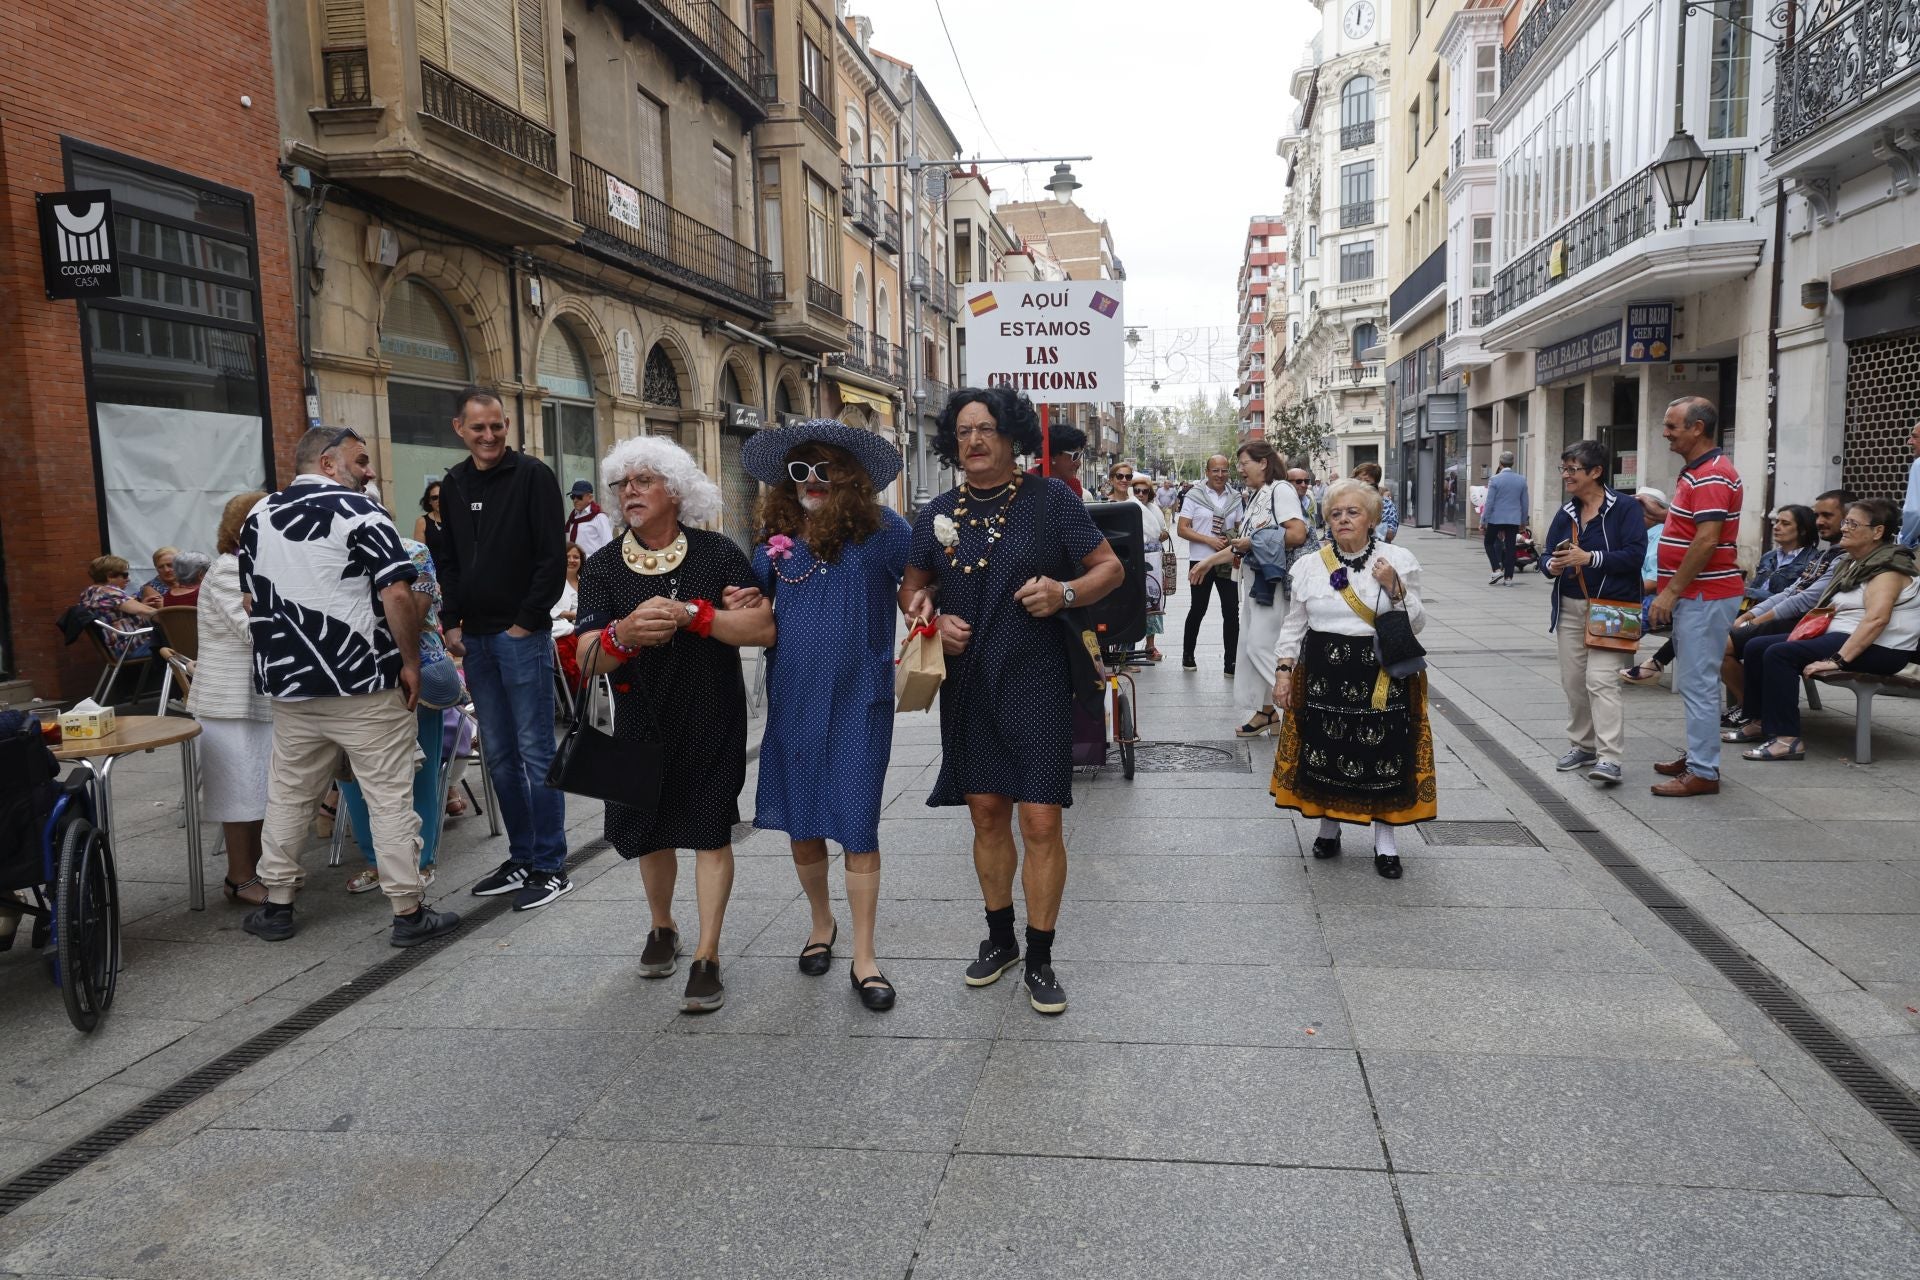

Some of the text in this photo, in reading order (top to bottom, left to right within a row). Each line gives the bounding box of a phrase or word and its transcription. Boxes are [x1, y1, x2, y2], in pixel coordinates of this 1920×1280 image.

[61, 263, 112, 276] COLOMBINI
[75, 276, 100, 287] CASA
[1021, 288, 1070, 310] AQUÍ
[1630, 307, 1669, 325] GRAN BAZAR
[1000, 321, 1091, 337] ESTAMOS
[1633, 327, 1665, 339] CHEN FU
[1025, 346, 1059, 364] LAS
[1537, 350, 1559, 371] GRAN
[1560, 338, 1589, 365] BAZAR
[1591, 327, 1619, 353] CHEN
[987, 371, 1098, 390] CRITICONAS
